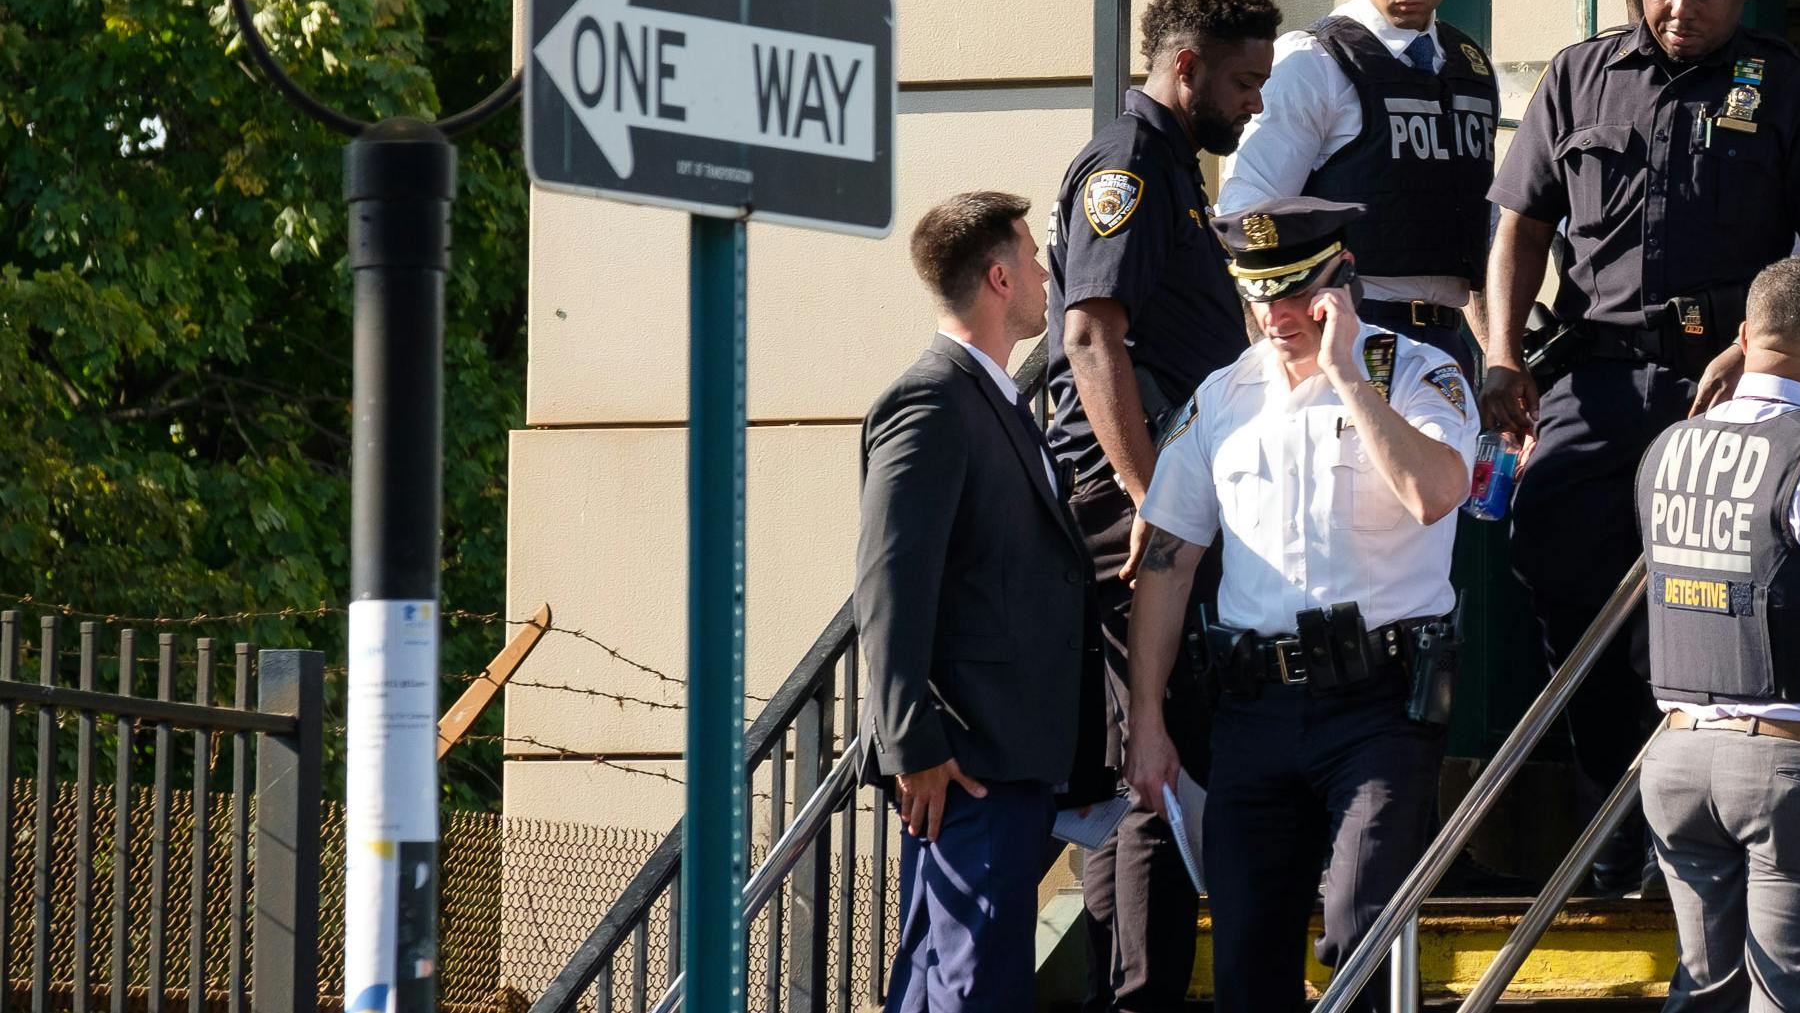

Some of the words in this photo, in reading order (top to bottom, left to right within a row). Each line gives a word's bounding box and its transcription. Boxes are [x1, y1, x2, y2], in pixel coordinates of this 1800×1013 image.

[571, 14, 687, 123] ONE
[752, 42, 862, 146] WAY
[1388, 112, 1495, 162] POLICE
[1654, 427, 1771, 500] NYPD
[1651, 491, 1755, 553] POLICE
[1664, 577, 1728, 610] DETECTIVE
